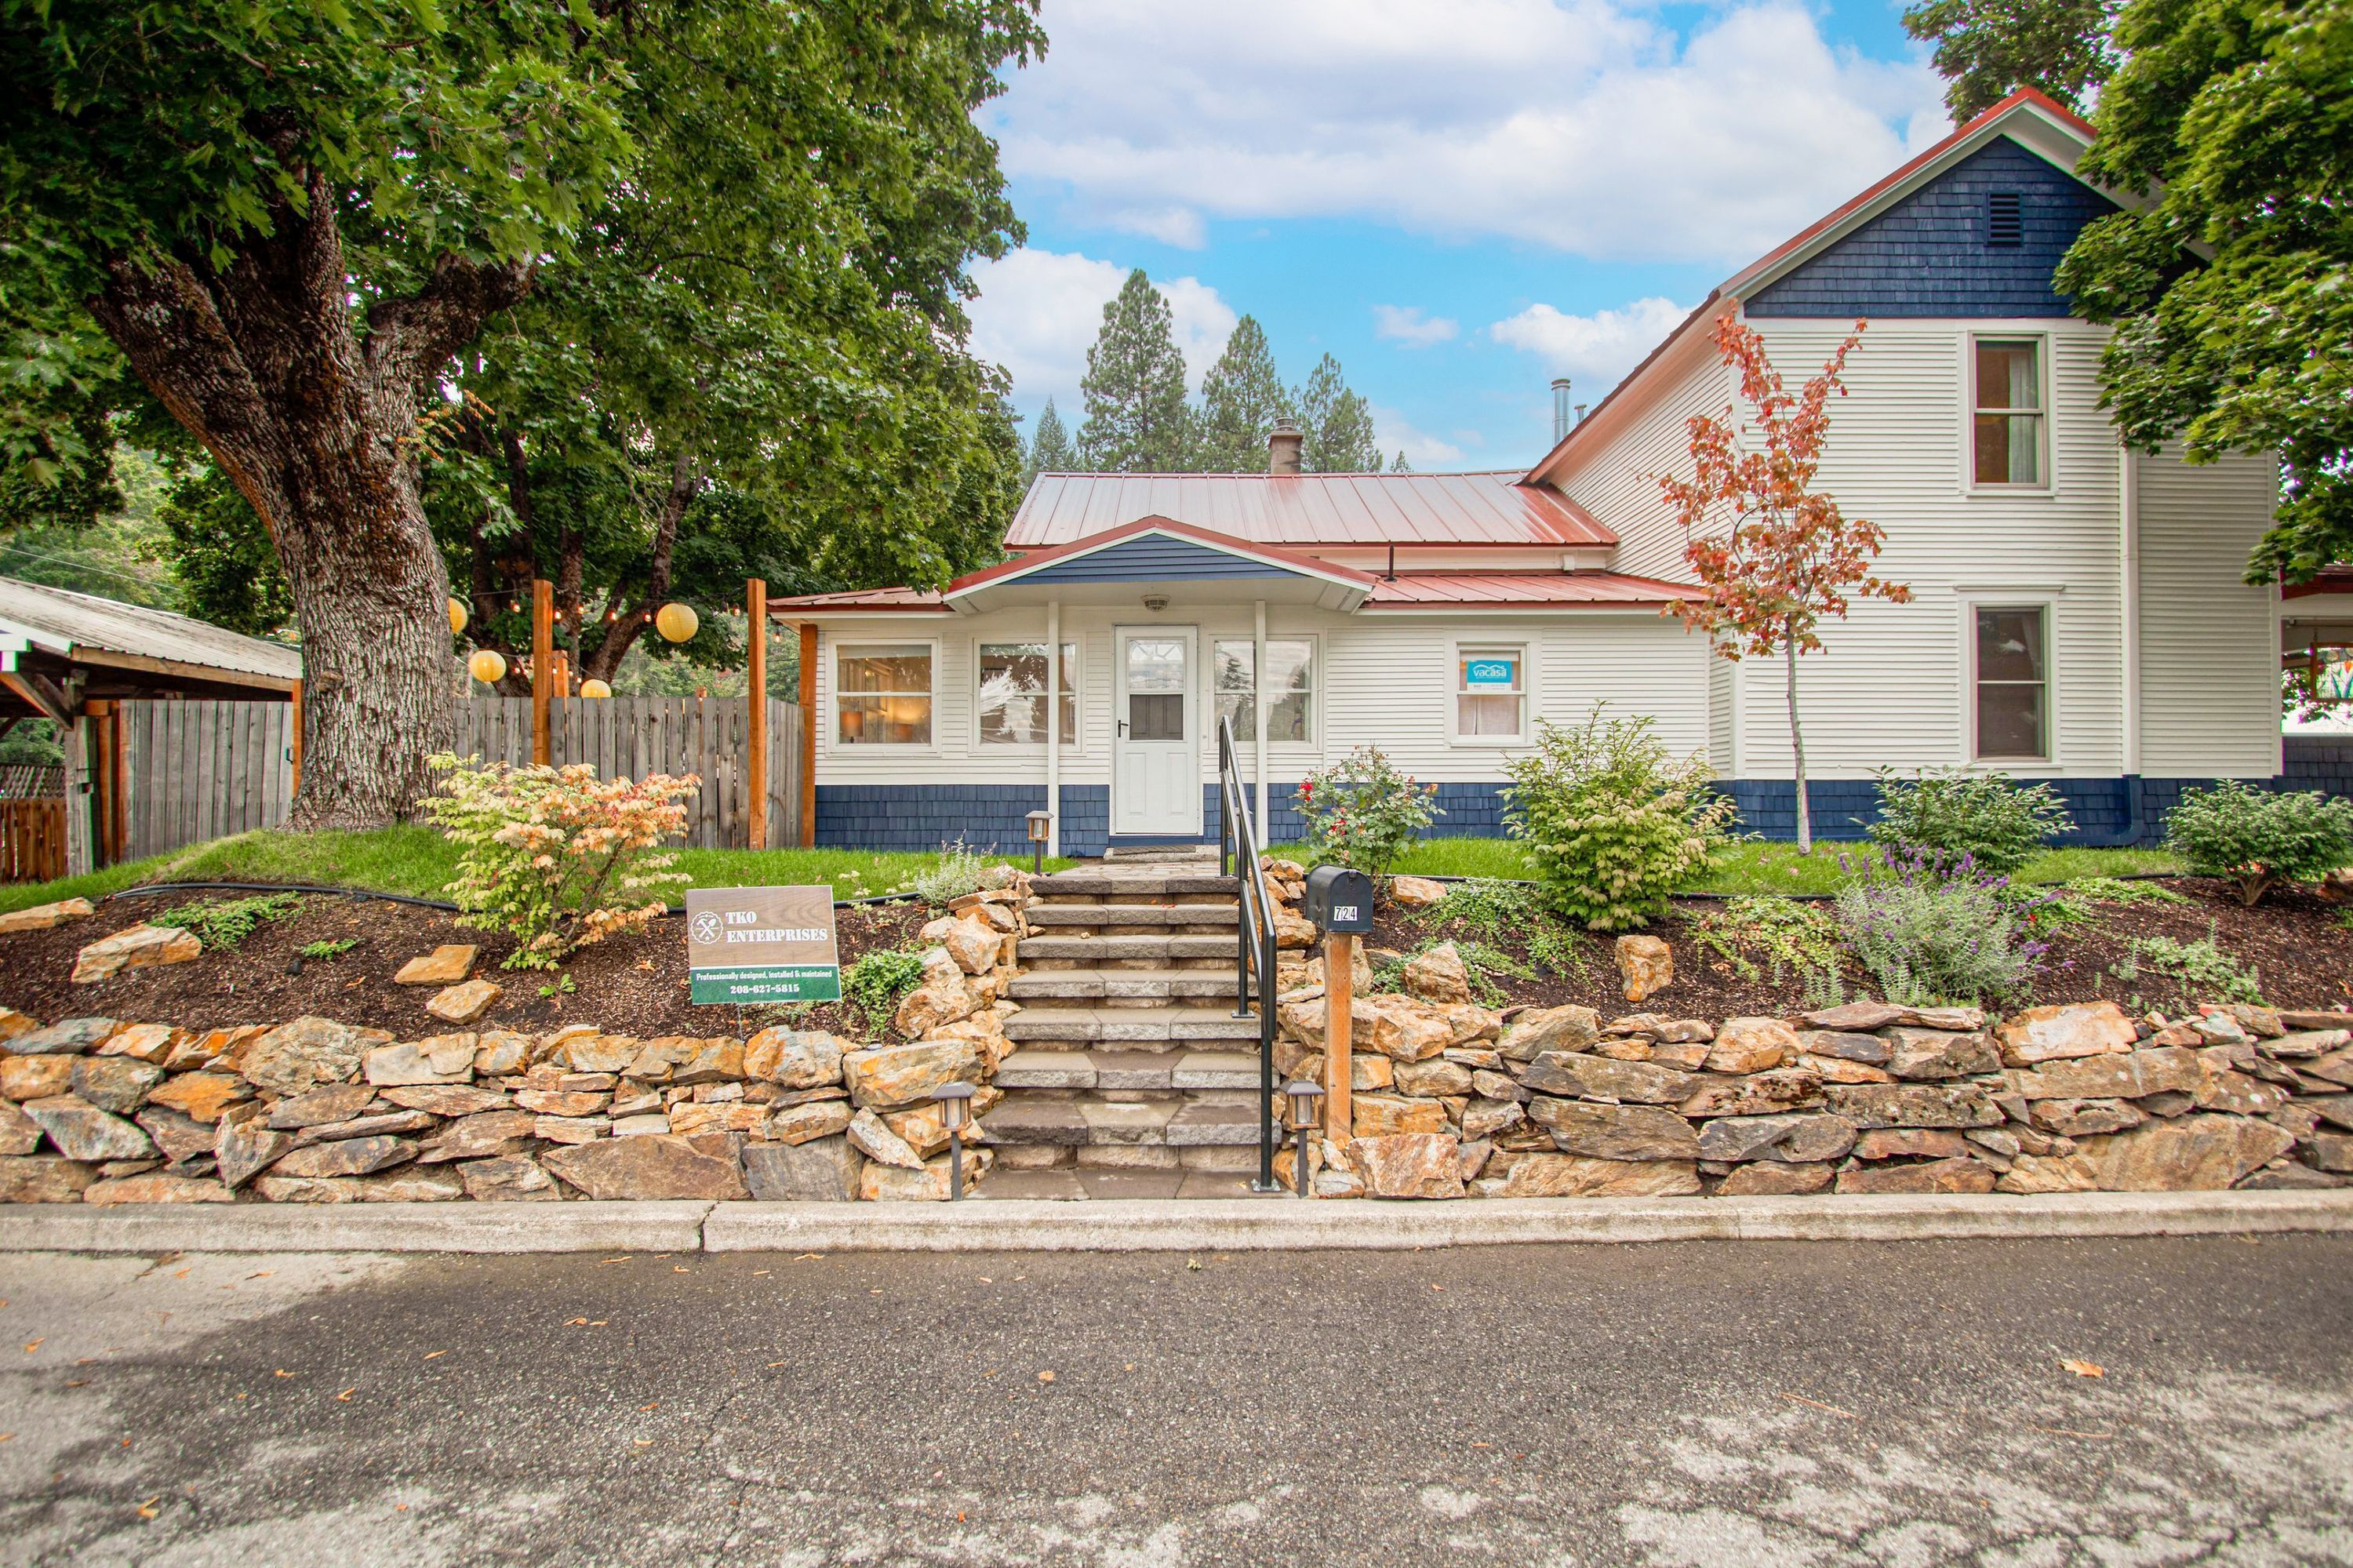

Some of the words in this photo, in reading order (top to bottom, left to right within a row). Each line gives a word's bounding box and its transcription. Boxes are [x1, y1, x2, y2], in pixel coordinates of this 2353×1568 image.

[1473, 668, 1507, 677] vacasa
[726, 911, 757, 924] TKO
[1336, 908, 1355, 919] 724
[726, 929, 828, 943] ENTERPRISES
[740, 971, 768, 980] designed,
[794, 970, 800, 978] &
[730, 984, 800, 994] 208-627-5815
